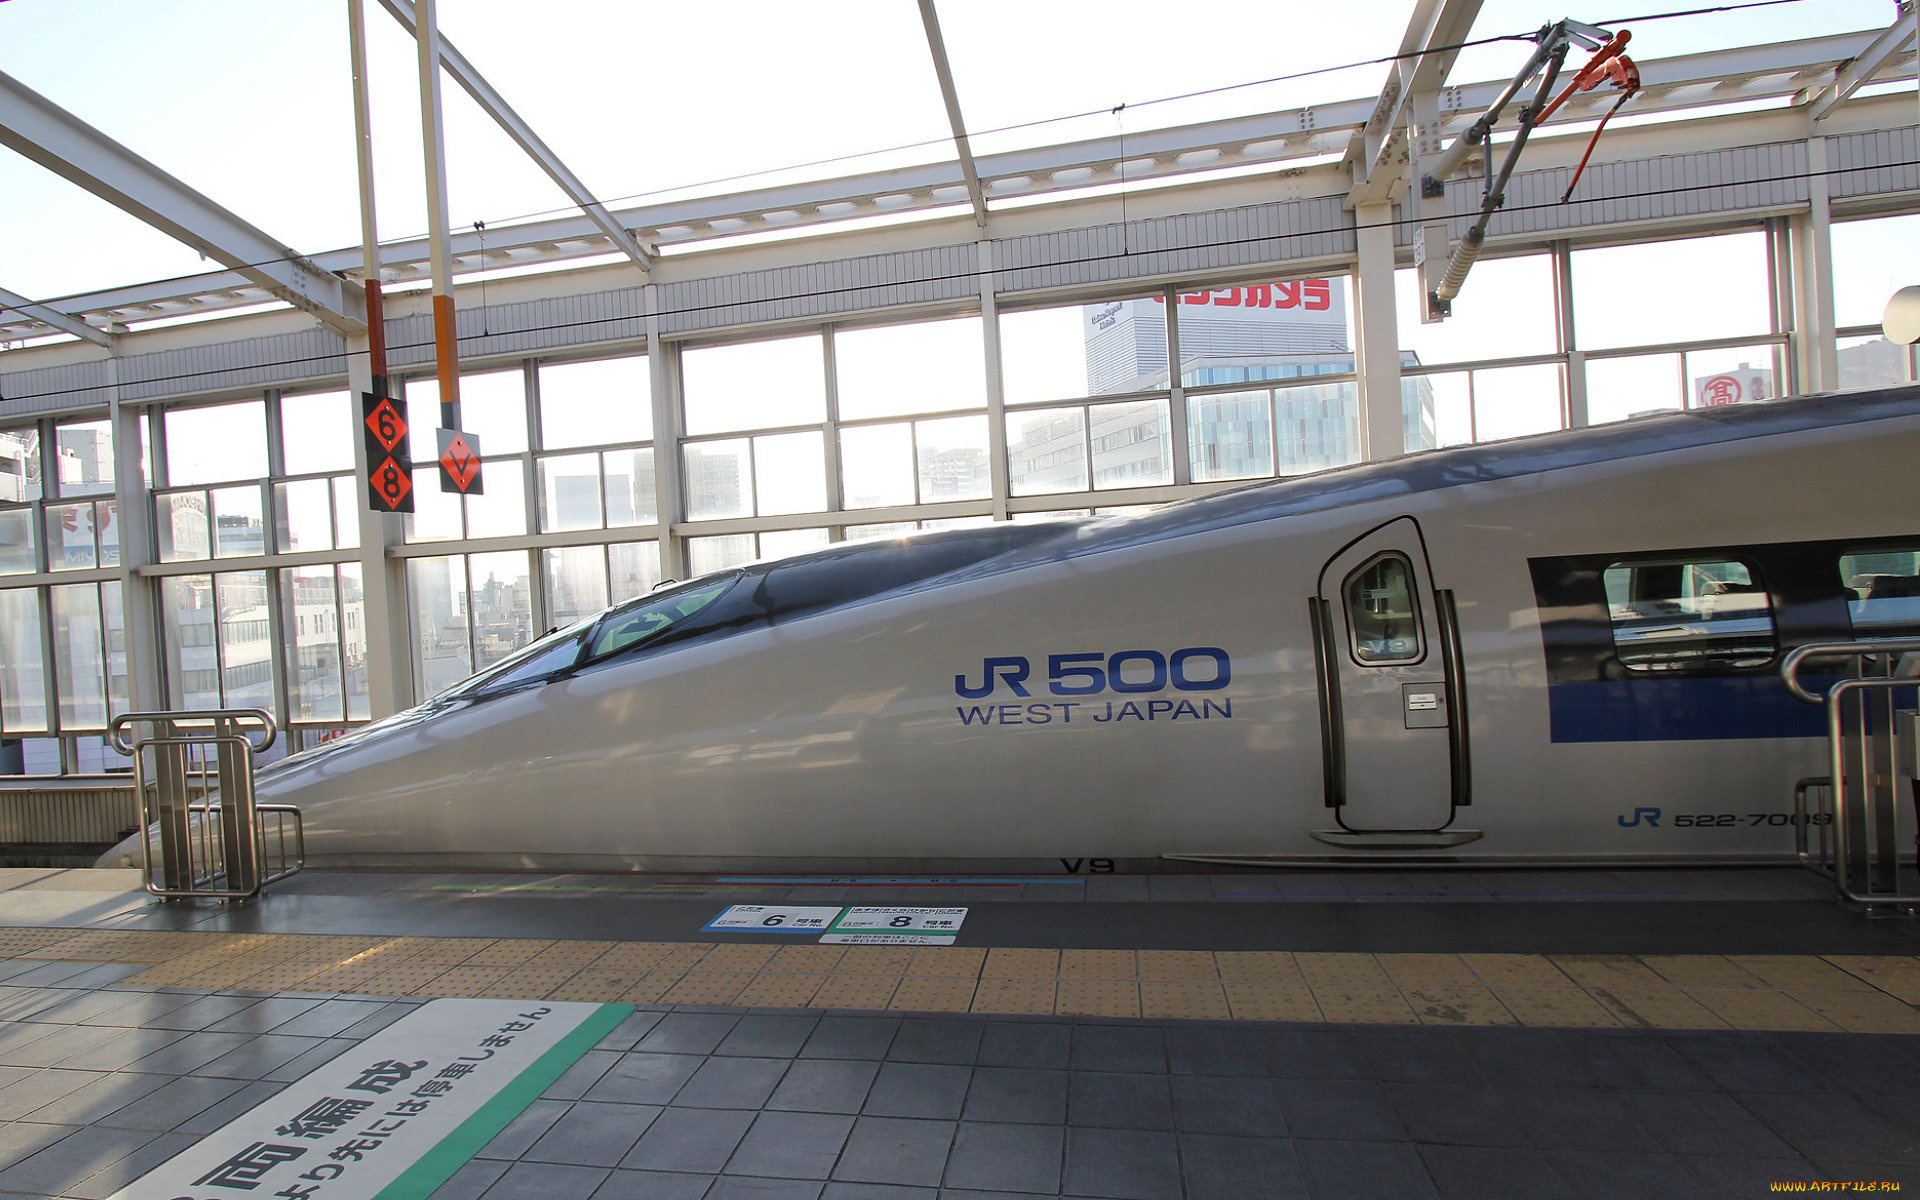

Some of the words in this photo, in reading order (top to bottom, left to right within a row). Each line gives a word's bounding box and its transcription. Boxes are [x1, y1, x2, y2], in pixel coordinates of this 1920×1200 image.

[378, 409, 397, 441] 6
[449, 450, 472, 476] V
[383, 467, 401, 497] 8
[954, 656, 1032, 699] JR
[1048, 646, 1231, 696] 500
[956, 703, 1081, 726] WEST
[1092, 697, 1233, 723] JAPAN
[1617, 807, 1662, 828] JR
[1060, 857, 1115, 874] V9
[762, 914, 787, 926] 6
[889, 916, 913, 927] 8
[168, 1059, 429, 1200] 両編成
